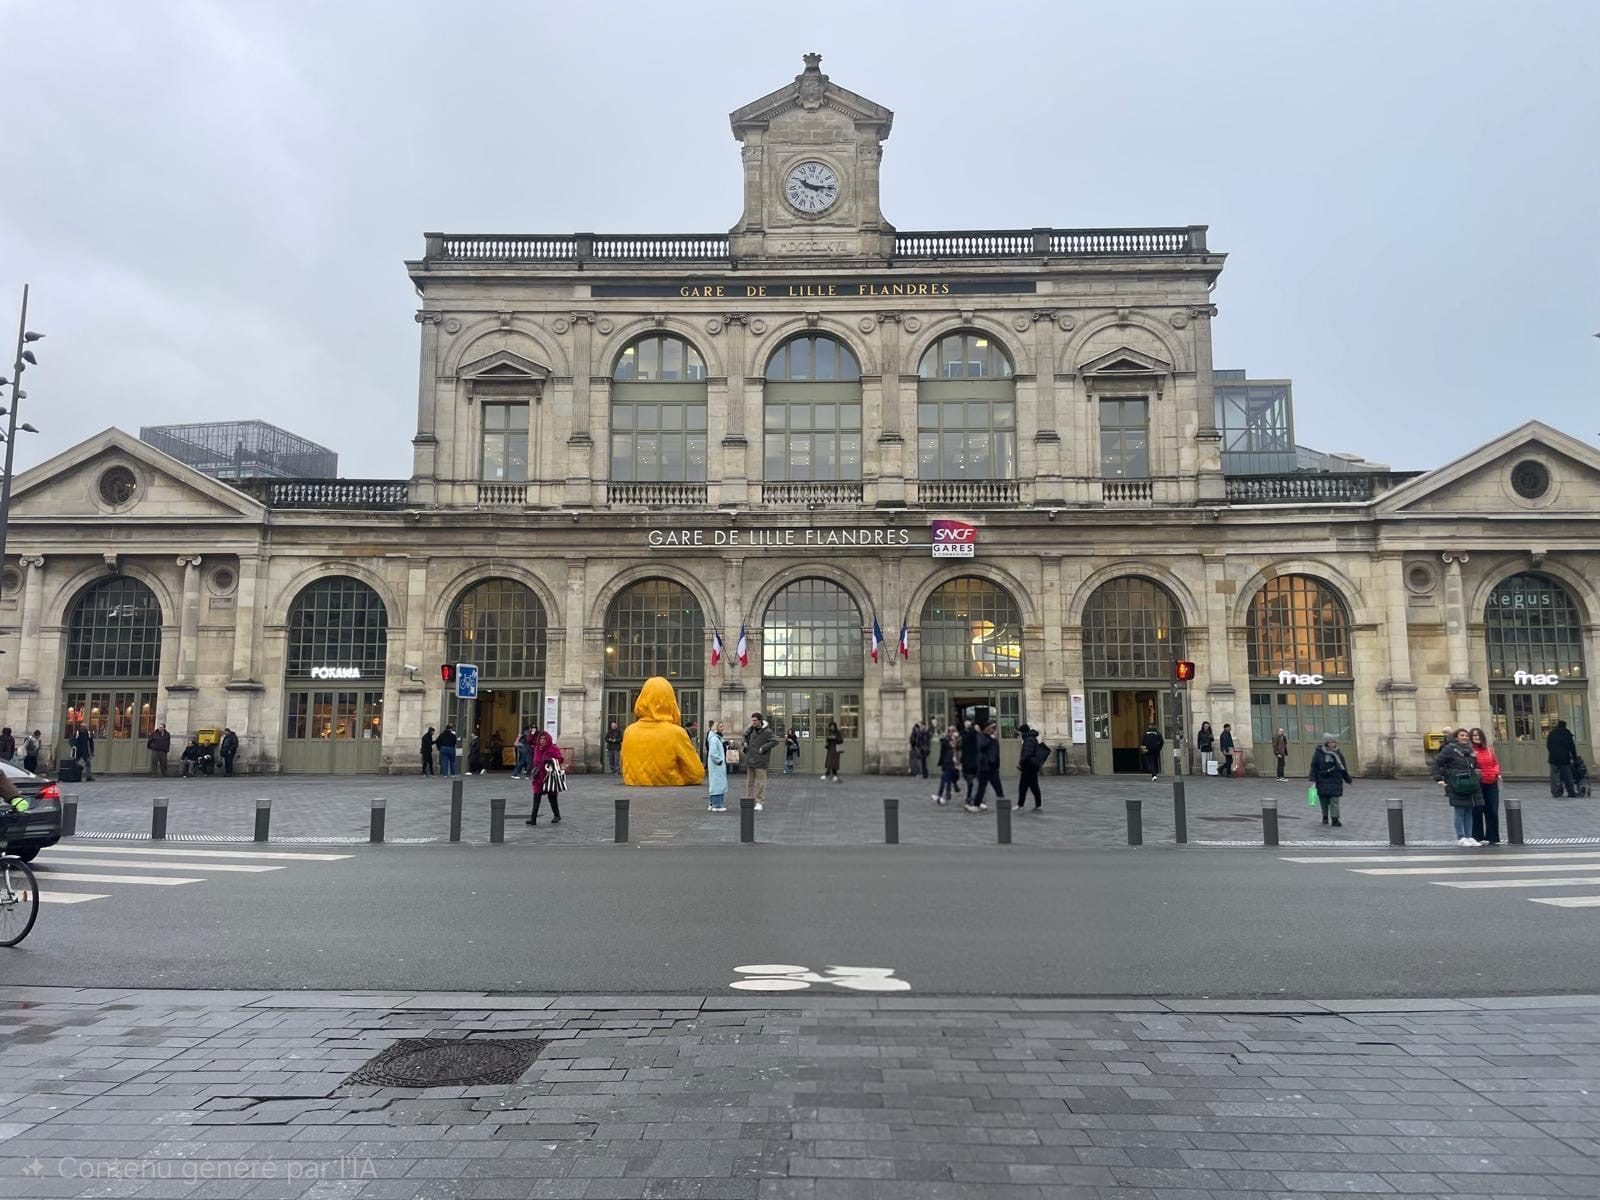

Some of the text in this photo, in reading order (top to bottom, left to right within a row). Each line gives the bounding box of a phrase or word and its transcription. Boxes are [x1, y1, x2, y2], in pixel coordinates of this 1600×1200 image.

[680, 284, 950, 297] GARE DE LILLE FLANDRES
[648, 529, 910, 545] GARE DE LILLE FLANDRES
[934, 528, 974, 540] SNCF
[1488, 592, 1550, 608] Regus
[1278, 670, 1324, 684] fnac
[1514, 670, 1559, 685] fnac
